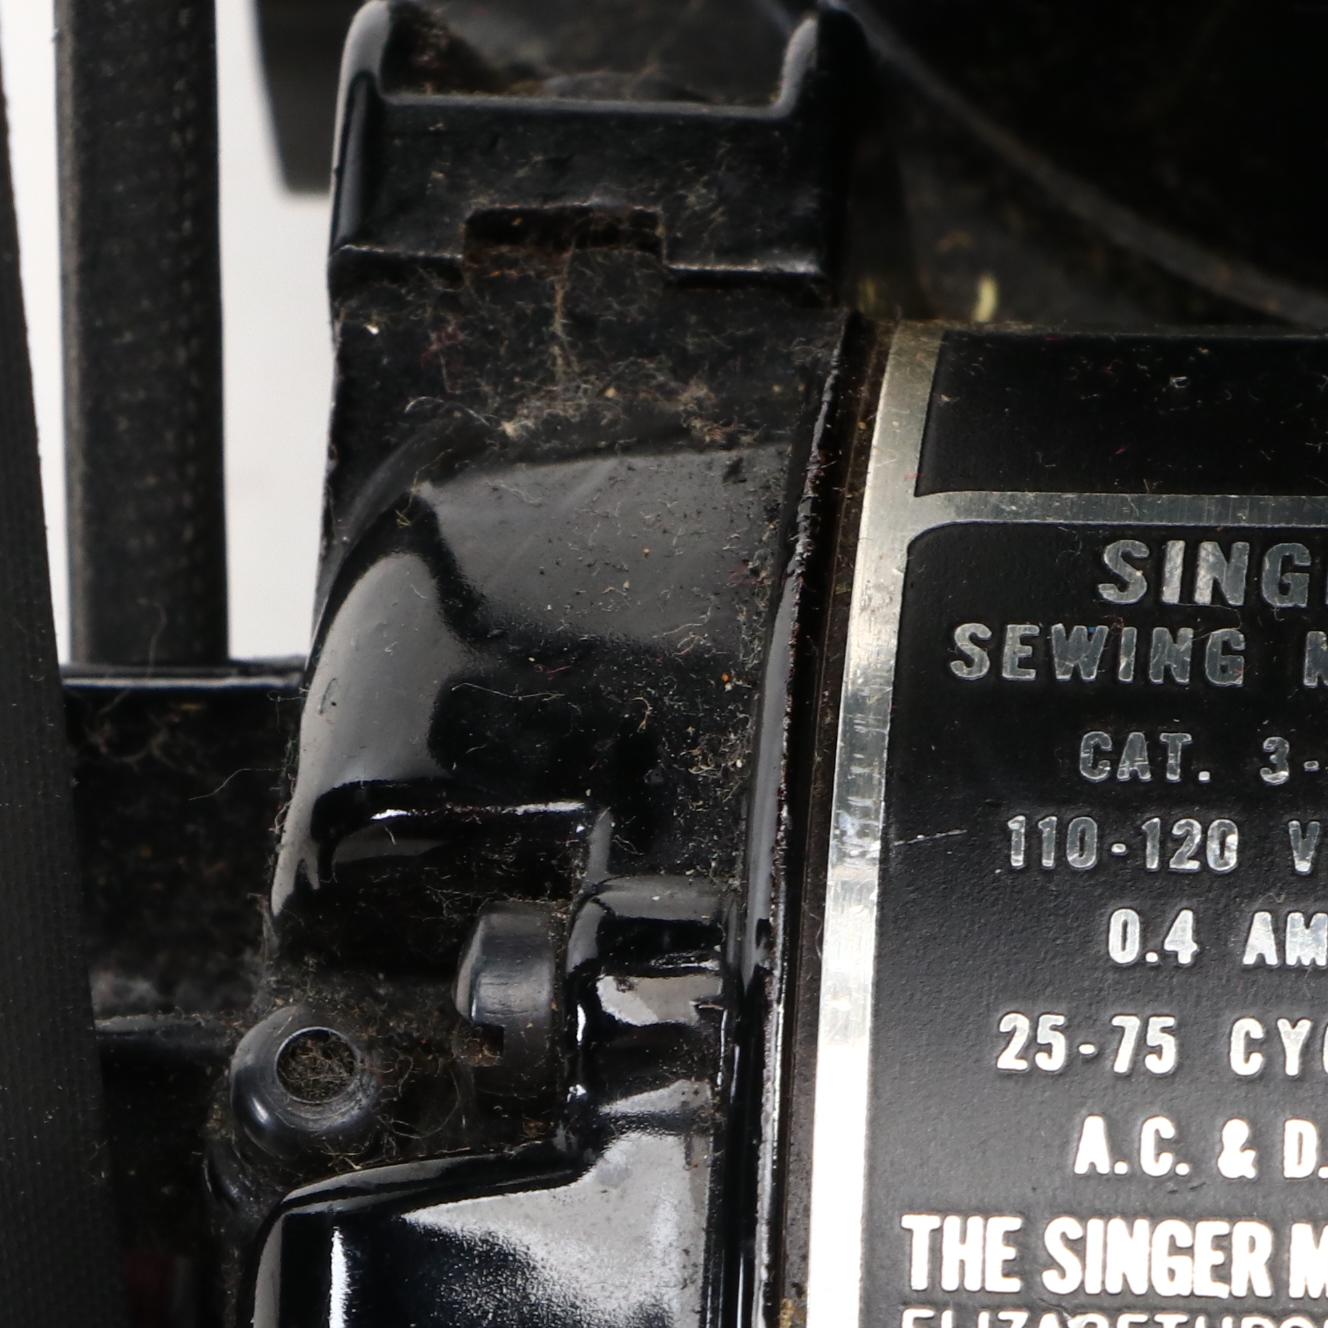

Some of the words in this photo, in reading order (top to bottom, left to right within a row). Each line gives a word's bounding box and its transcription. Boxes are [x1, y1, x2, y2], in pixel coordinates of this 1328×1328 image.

[948, 622, 1246, 686] SEWING
[1078, 730, 1212, 784] CAT.
[1007, 815, 1240, 873] 110-120
[1107, 908, 1199, 967] 0.4
[995, 1011, 1179, 1076] 25-75
[1216, 1118, 1258, 1180] &
[900, 1213, 1023, 1294] THE
[1041, 1216, 1273, 1300] SINGER
